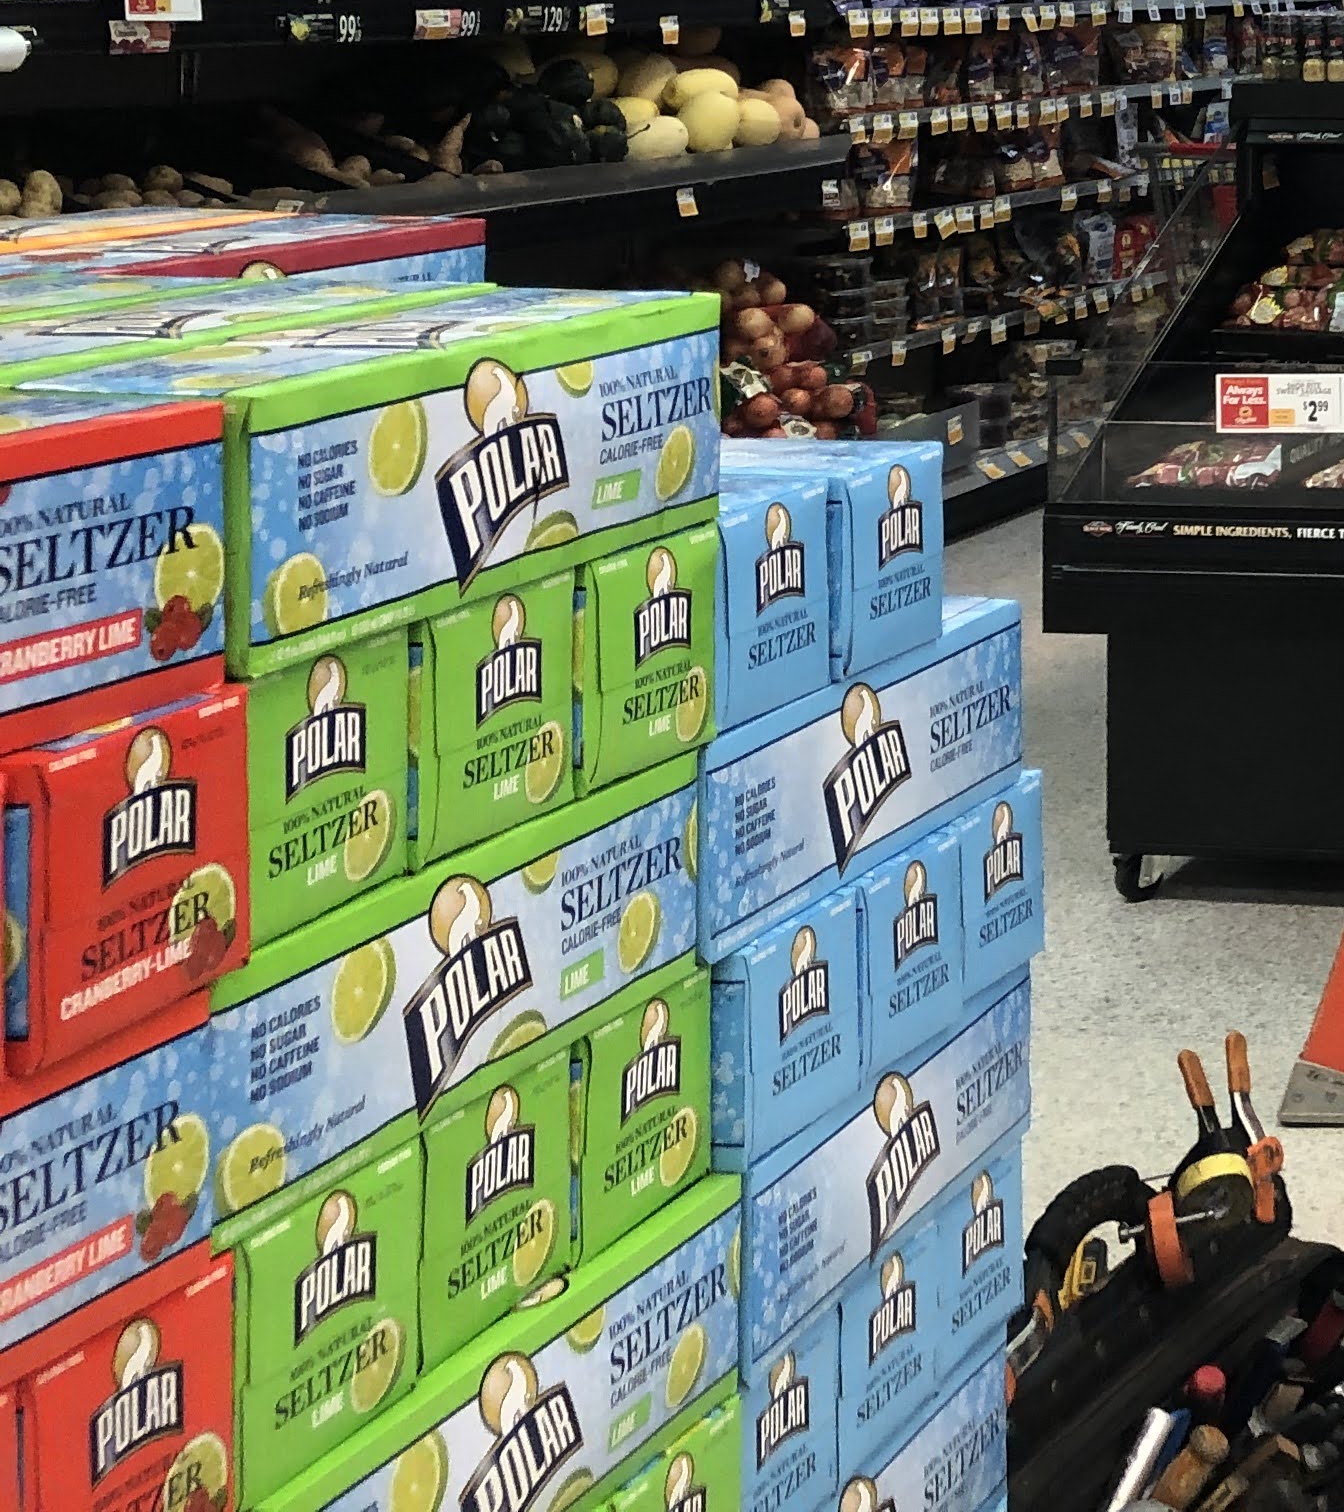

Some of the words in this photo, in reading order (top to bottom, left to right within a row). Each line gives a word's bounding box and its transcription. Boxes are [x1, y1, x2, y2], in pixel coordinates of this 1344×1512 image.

[599, 379, 625, 397] 100%
[626, 365, 678, 389] NATURAL
[1223, 395, 1240, 404] For
[1225, 385, 1264, 396] Always
[601, 377, 712, 442] SELTZER
[298, 453, 311, 469] NO
[313, 440, 358, 465] CALORIES
[298, 474, 311, 489] NO
[313, 463, 344, 485] SUGAR
[600, 434, 664, 465] CALORIE-FREE
[38, 492, 133, 526] NATURAL
[298, 495, 312, 511] NO
[314, 480, 356, 507] CAFFEINE
[452, 416, 565, 560] POLAR
[596, 480, 625, 504] LIME
[299, 516, 312, 532] NO
[314, 503, 349, 527] SODIUM
[880, 508, 920, 560] POLAR
[1173, 525, 1213, 536] SIMPLE
[1216, 526, 1292, 539] INGREDIENTS,
[1297, 528, 1336, 539] FIERCE
[0, 506, 198, 596] SELTZER
[298, 566, 362, 600] Refreshingly
[364, 551, 408, 578] Natural
[759, 549, 802, 606] POLAR
[636, 594, 691, 656] POLAR
[869, 577, 932, 620] SELTZER
[0, 625, 94, 677] RANBERRY
[99, 617, 136, 651] LIME
[746, 622, 817, 670] SELTZER
[621, 675, 701, 727] SELTZER
[929, 683, 1013, 754] SELTZER
[950, 680, 985, 707] NATURAL
[291, 713, 363, 786] POLAR
[835, 725, 907, 850] POLAR
[110, 795, 193, 865] POLAR
[267, 799, 379, 881] SELTZER
[592, 833, 643, 878] NATURAL
[306, 855, 339, 886] LIME
[559, 836, 684, 931] SELTZER
[987, 840, 1020, 893] POLAR
[80, 891, 211, 983] SELTZER
[560, 907, 622, 956] CALORIE-FREE
[897, 901, 935, 960] POLAR
[979, 898, 1033, 948] SELTZER
[60, 940, 194, 1022] CRANBERRY-LIME
[563, 965, 591, 991] LIME
[888, 964, 949, 1018] SELTZER
[421, 929, 527, 1088] POLAR
[470, 1144, 531, 1209] POLAR
[446, 1214, 545, 1300] SELTZER
[301, 1253, 374, 1332] POLAR
[608, 1265, 729, 1385] SELTZER
[274, 1324, 390, 1431] SELTZER
[95, 1388, 178, 1470] POLAR
